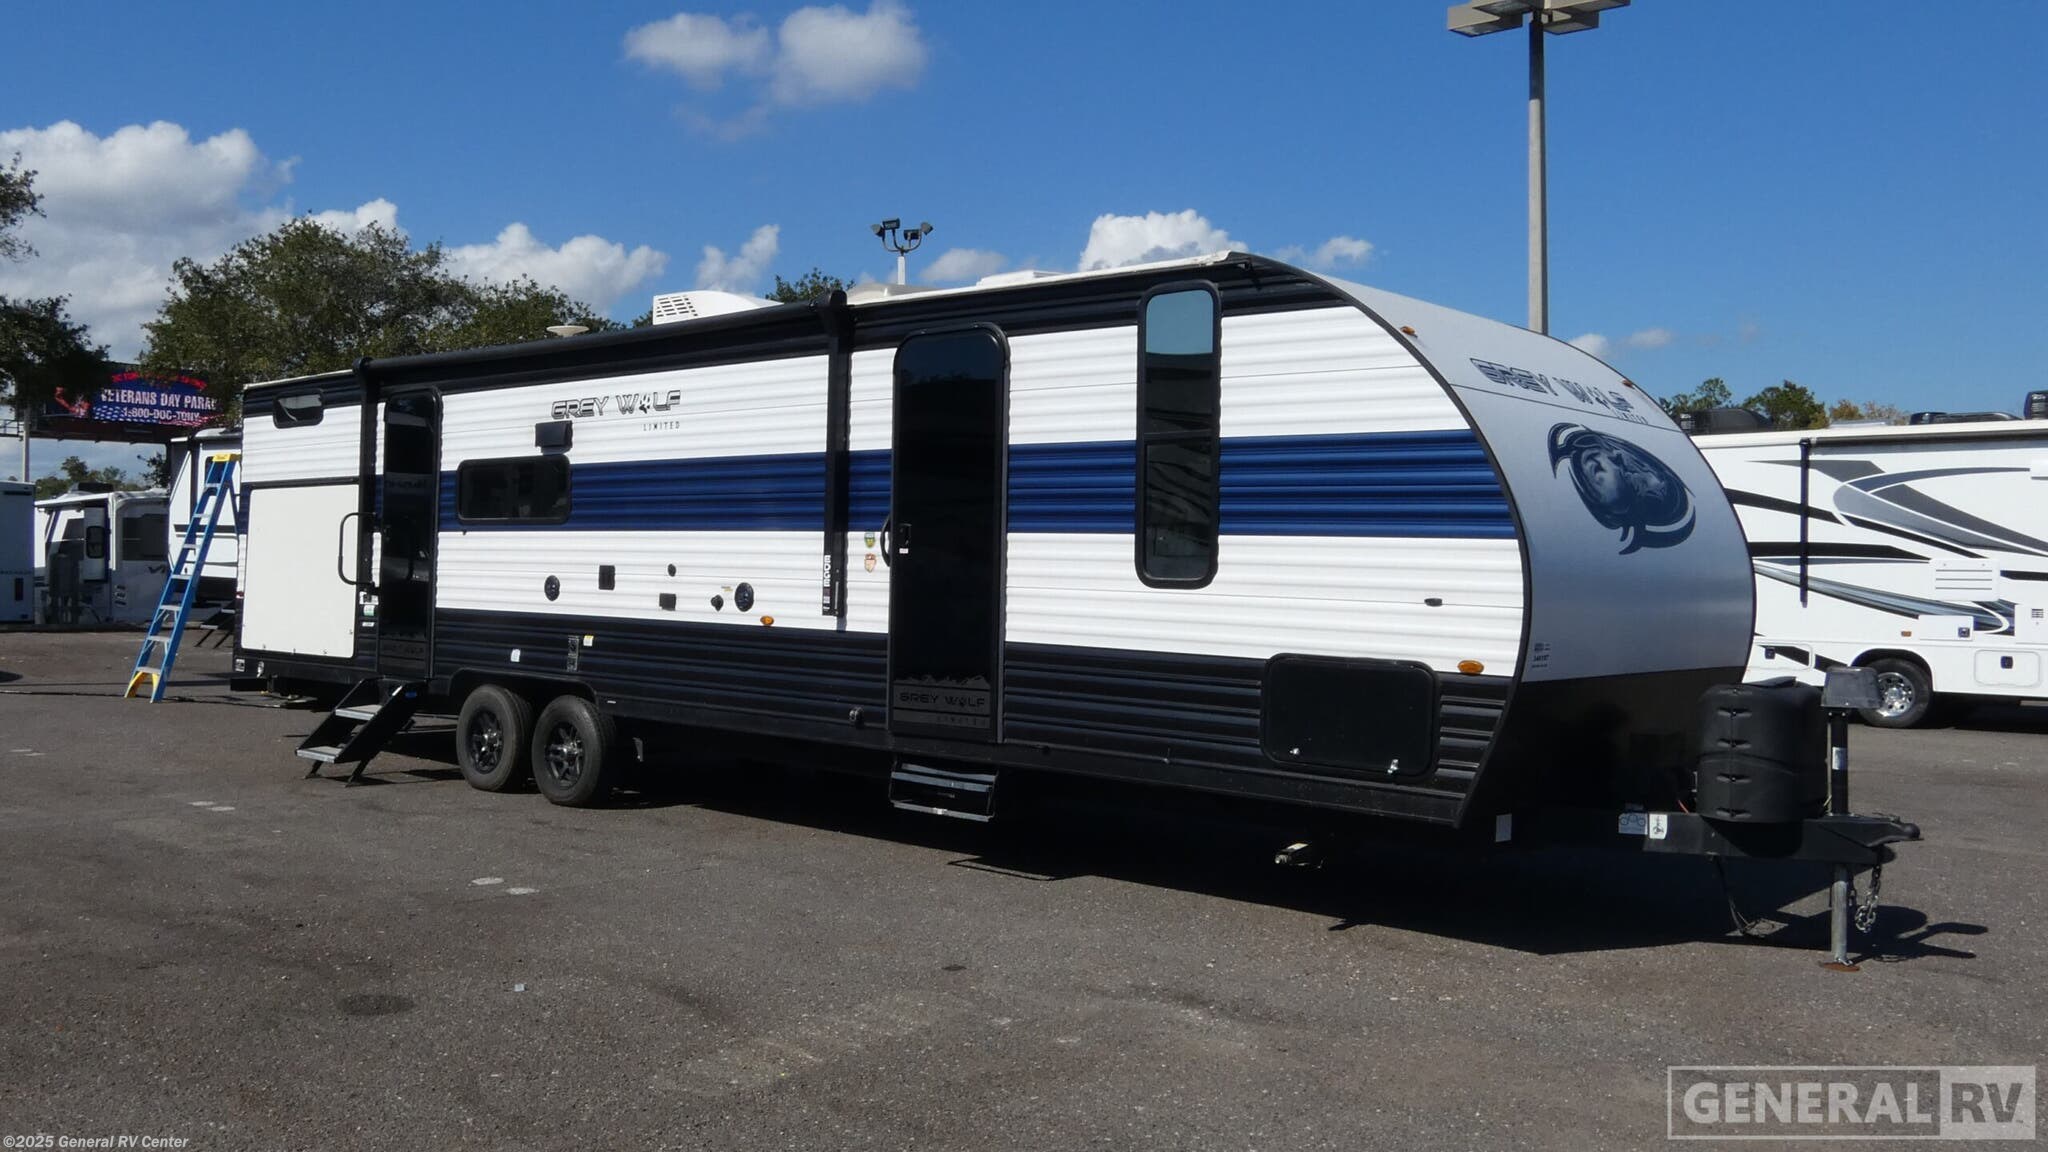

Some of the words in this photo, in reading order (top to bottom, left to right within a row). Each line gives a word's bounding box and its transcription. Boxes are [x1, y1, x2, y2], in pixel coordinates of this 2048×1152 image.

[160, 393, 181, 408] DAY
[551, 396, 609, 419] GREY
[643, 420, 680, 432] LIMITED
